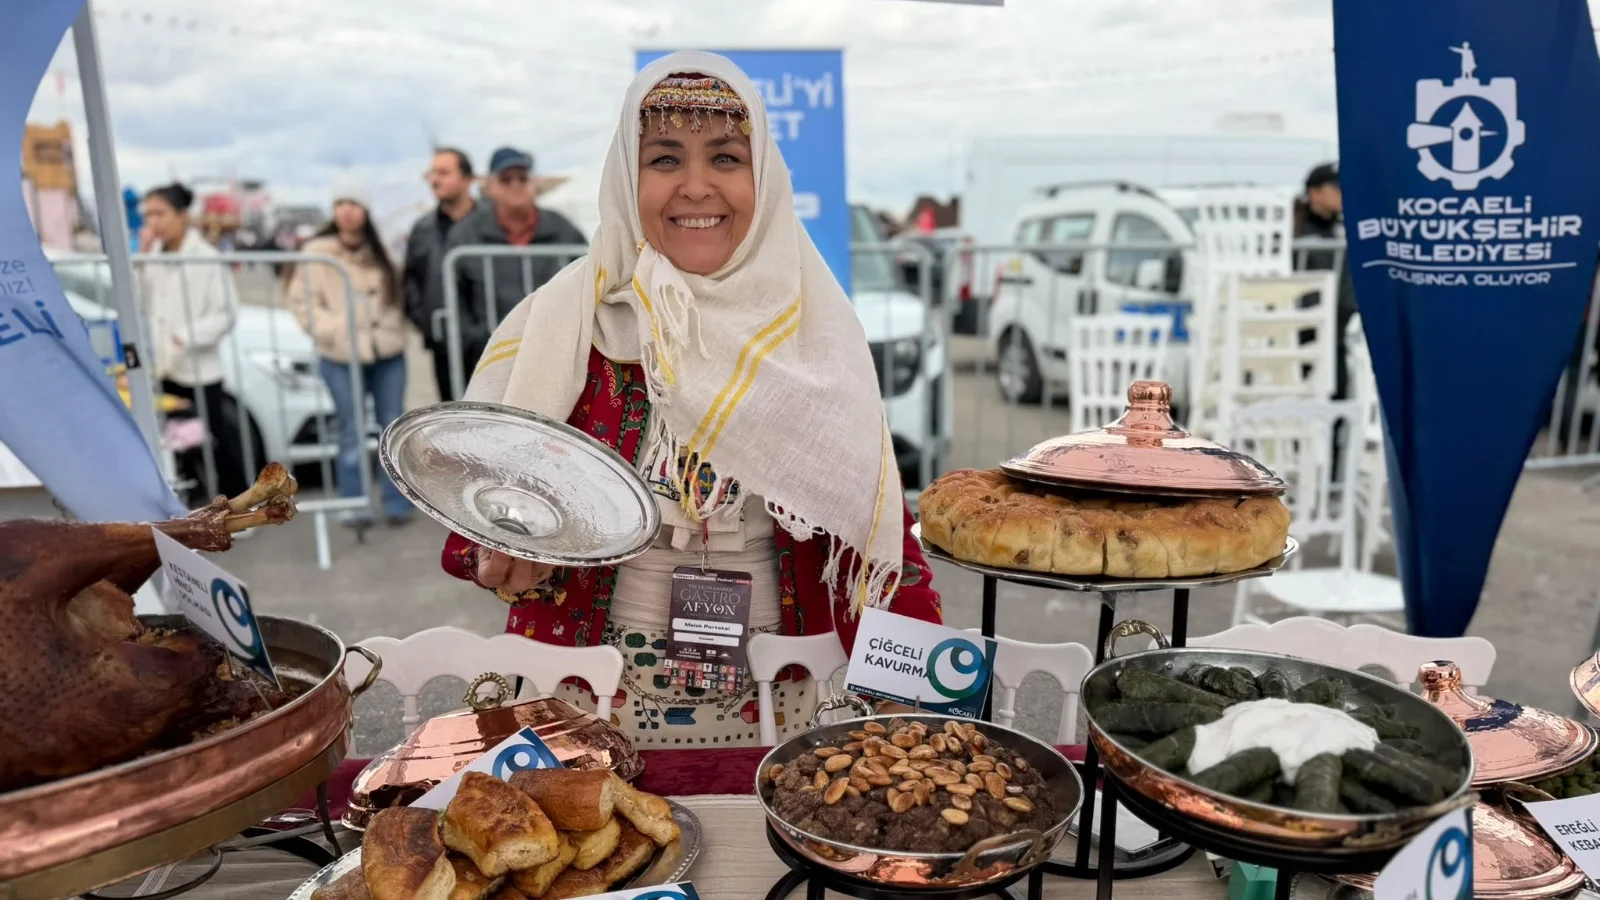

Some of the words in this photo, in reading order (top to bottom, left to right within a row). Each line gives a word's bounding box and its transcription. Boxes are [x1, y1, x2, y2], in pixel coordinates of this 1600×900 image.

[1397, 195, 1532, 216] KOCAELİ
[1357, 214, 1582, 243] BÜYÜKŞEHİR
[1385, 241, 1552, 262] BELEDİYESİ
[1473, 271, 1552, 286] OLUYOR
[680, 588, 741, 606] GASTRO
[682, 601, 736, 616] AFYON
[868, 637, 924, 661] ÇİĞCELİ
[1554, 818, 1600, 836] EREĞLİ
[1568, 837, 1600, 852] KEBA
